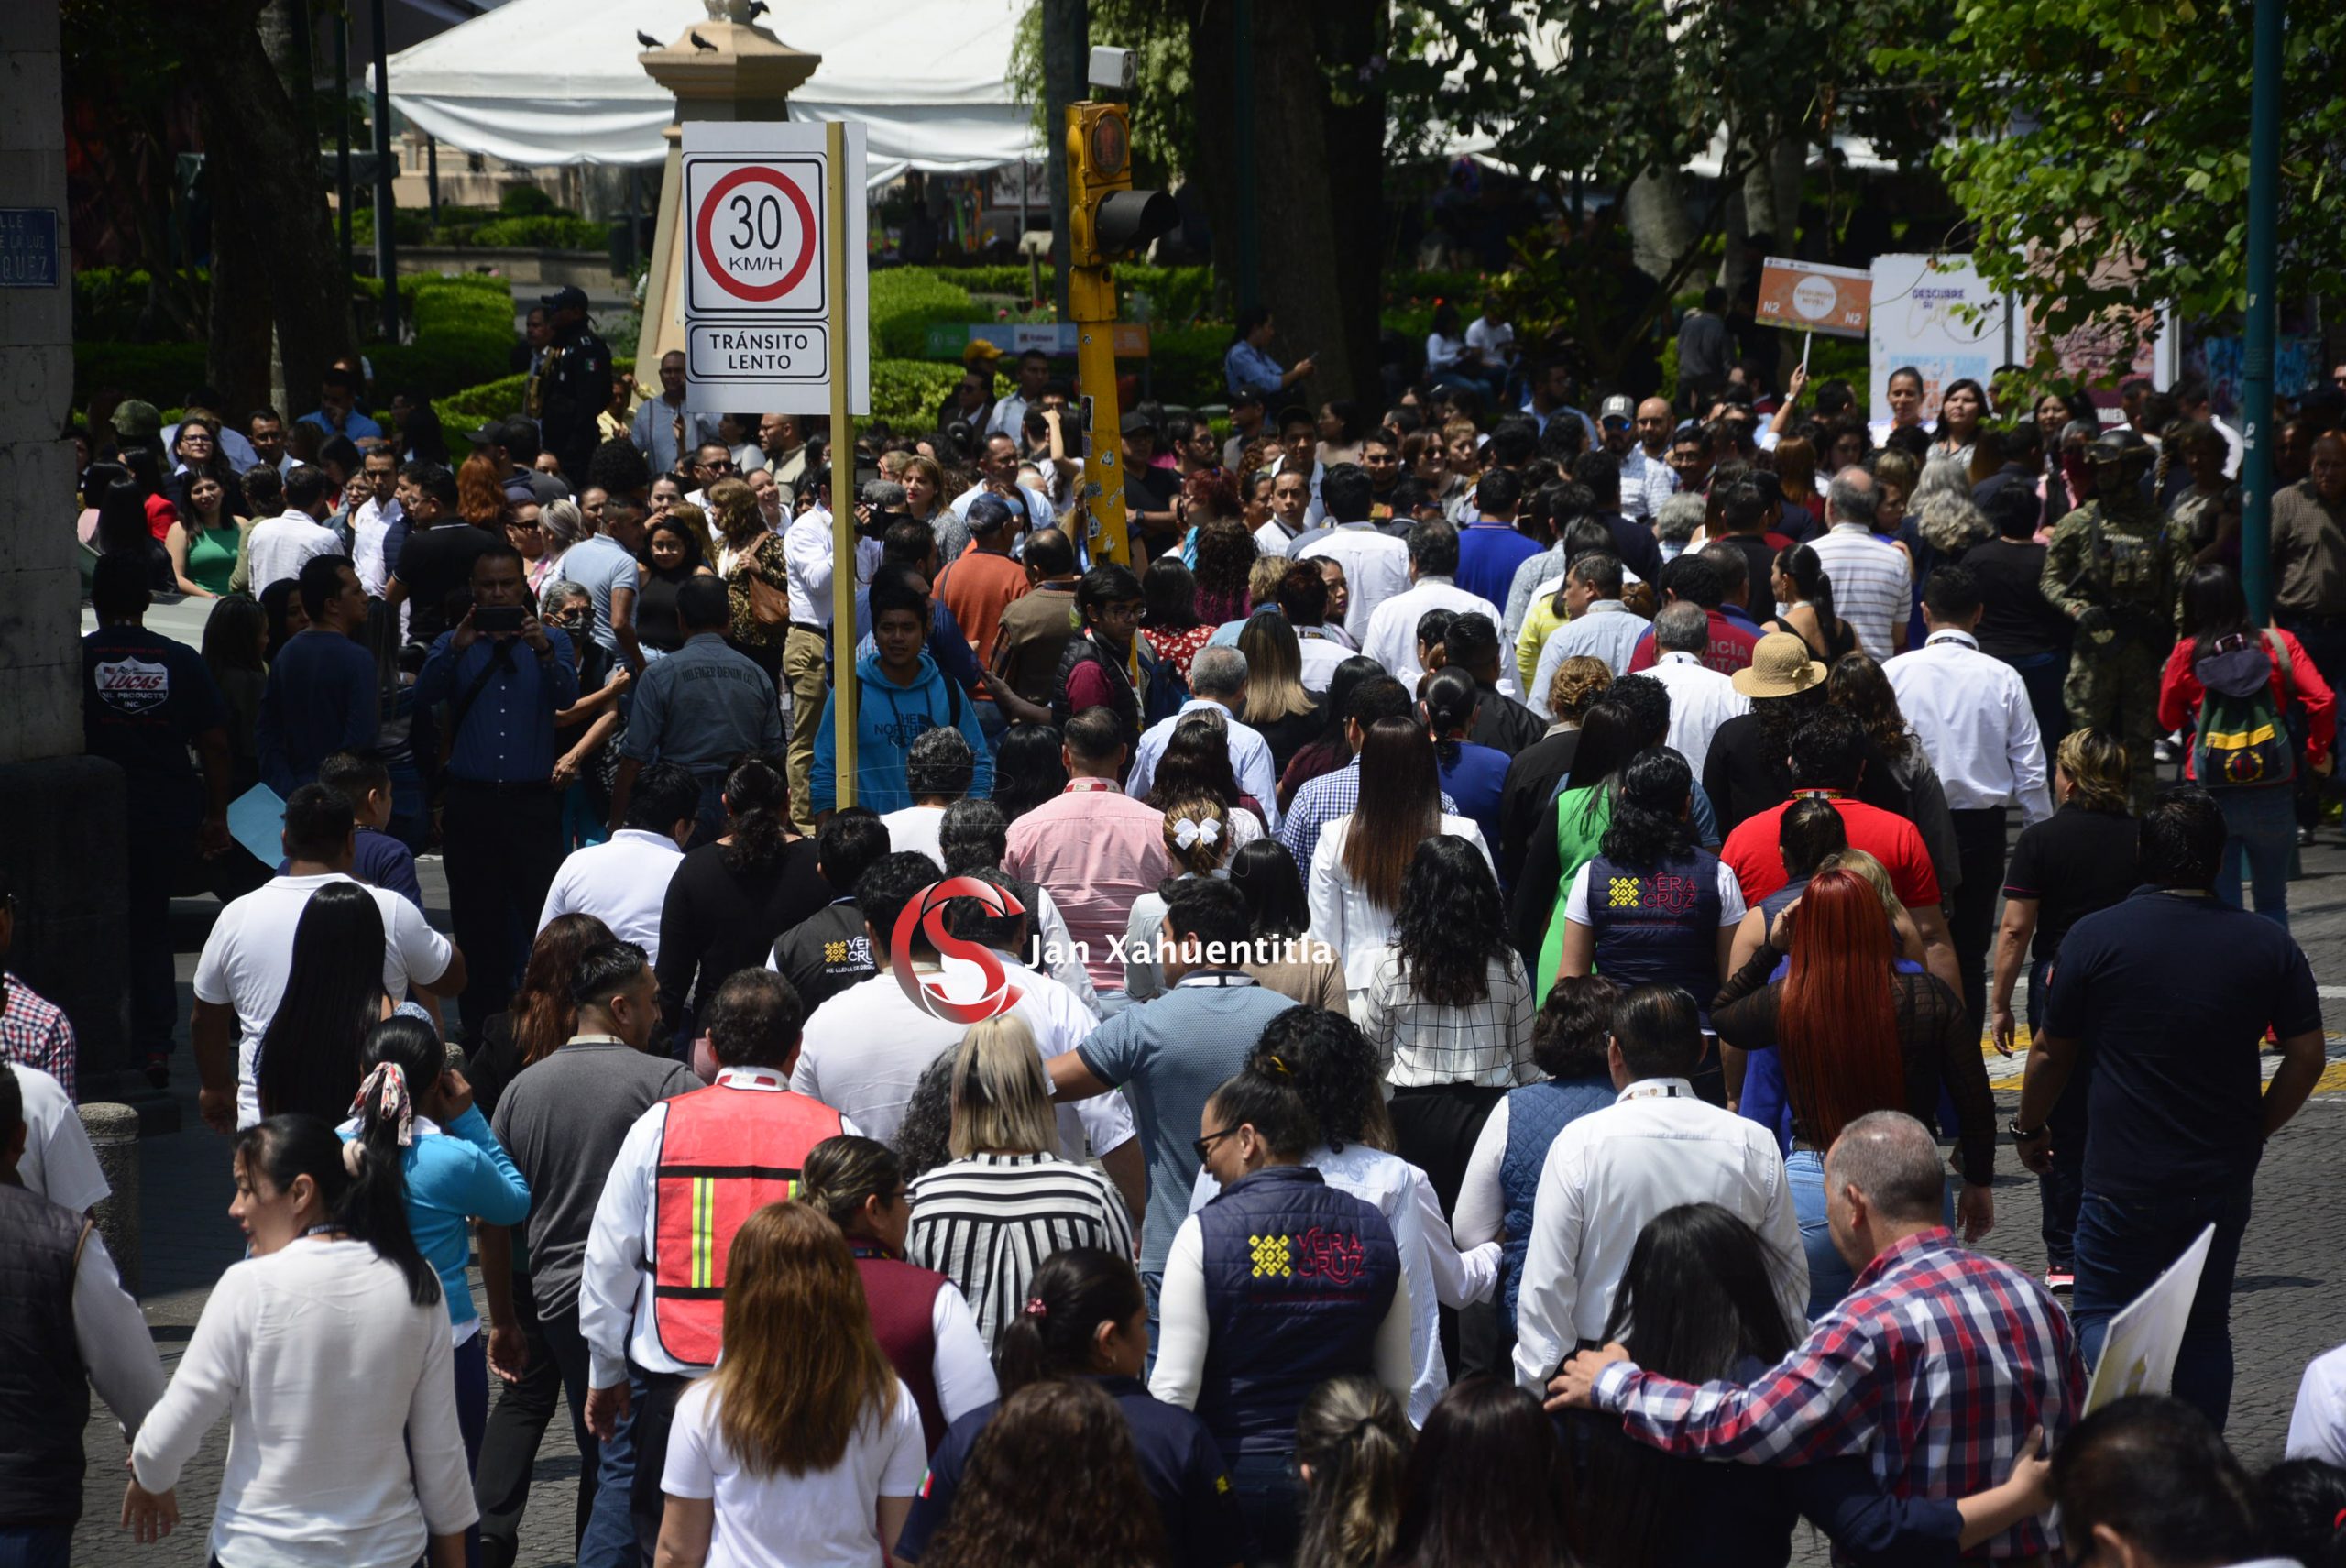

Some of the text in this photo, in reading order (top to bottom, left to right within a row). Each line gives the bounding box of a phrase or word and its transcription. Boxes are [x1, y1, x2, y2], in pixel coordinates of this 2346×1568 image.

[729, 194, 782, 250] 30
[3, 256, 49, 280] QUEZ
[729, 257, 782, 271] KM/H
[1763, 301, 1781, 314] N2
[1845, 311, 1863, 325] N2
[709, 331, 808, 350] TRÁNSITO
[729, 355, 792, 369] LENTO
[104, 674, 163, 689] LUCAS
[1643, 872, 1699, 893] VERA
[1643, 893, 1698, 914] CRUZ
[1295, 1226, 1365, 1256] VERA
[1297, 1255, 1365, 1285] CRUZ
